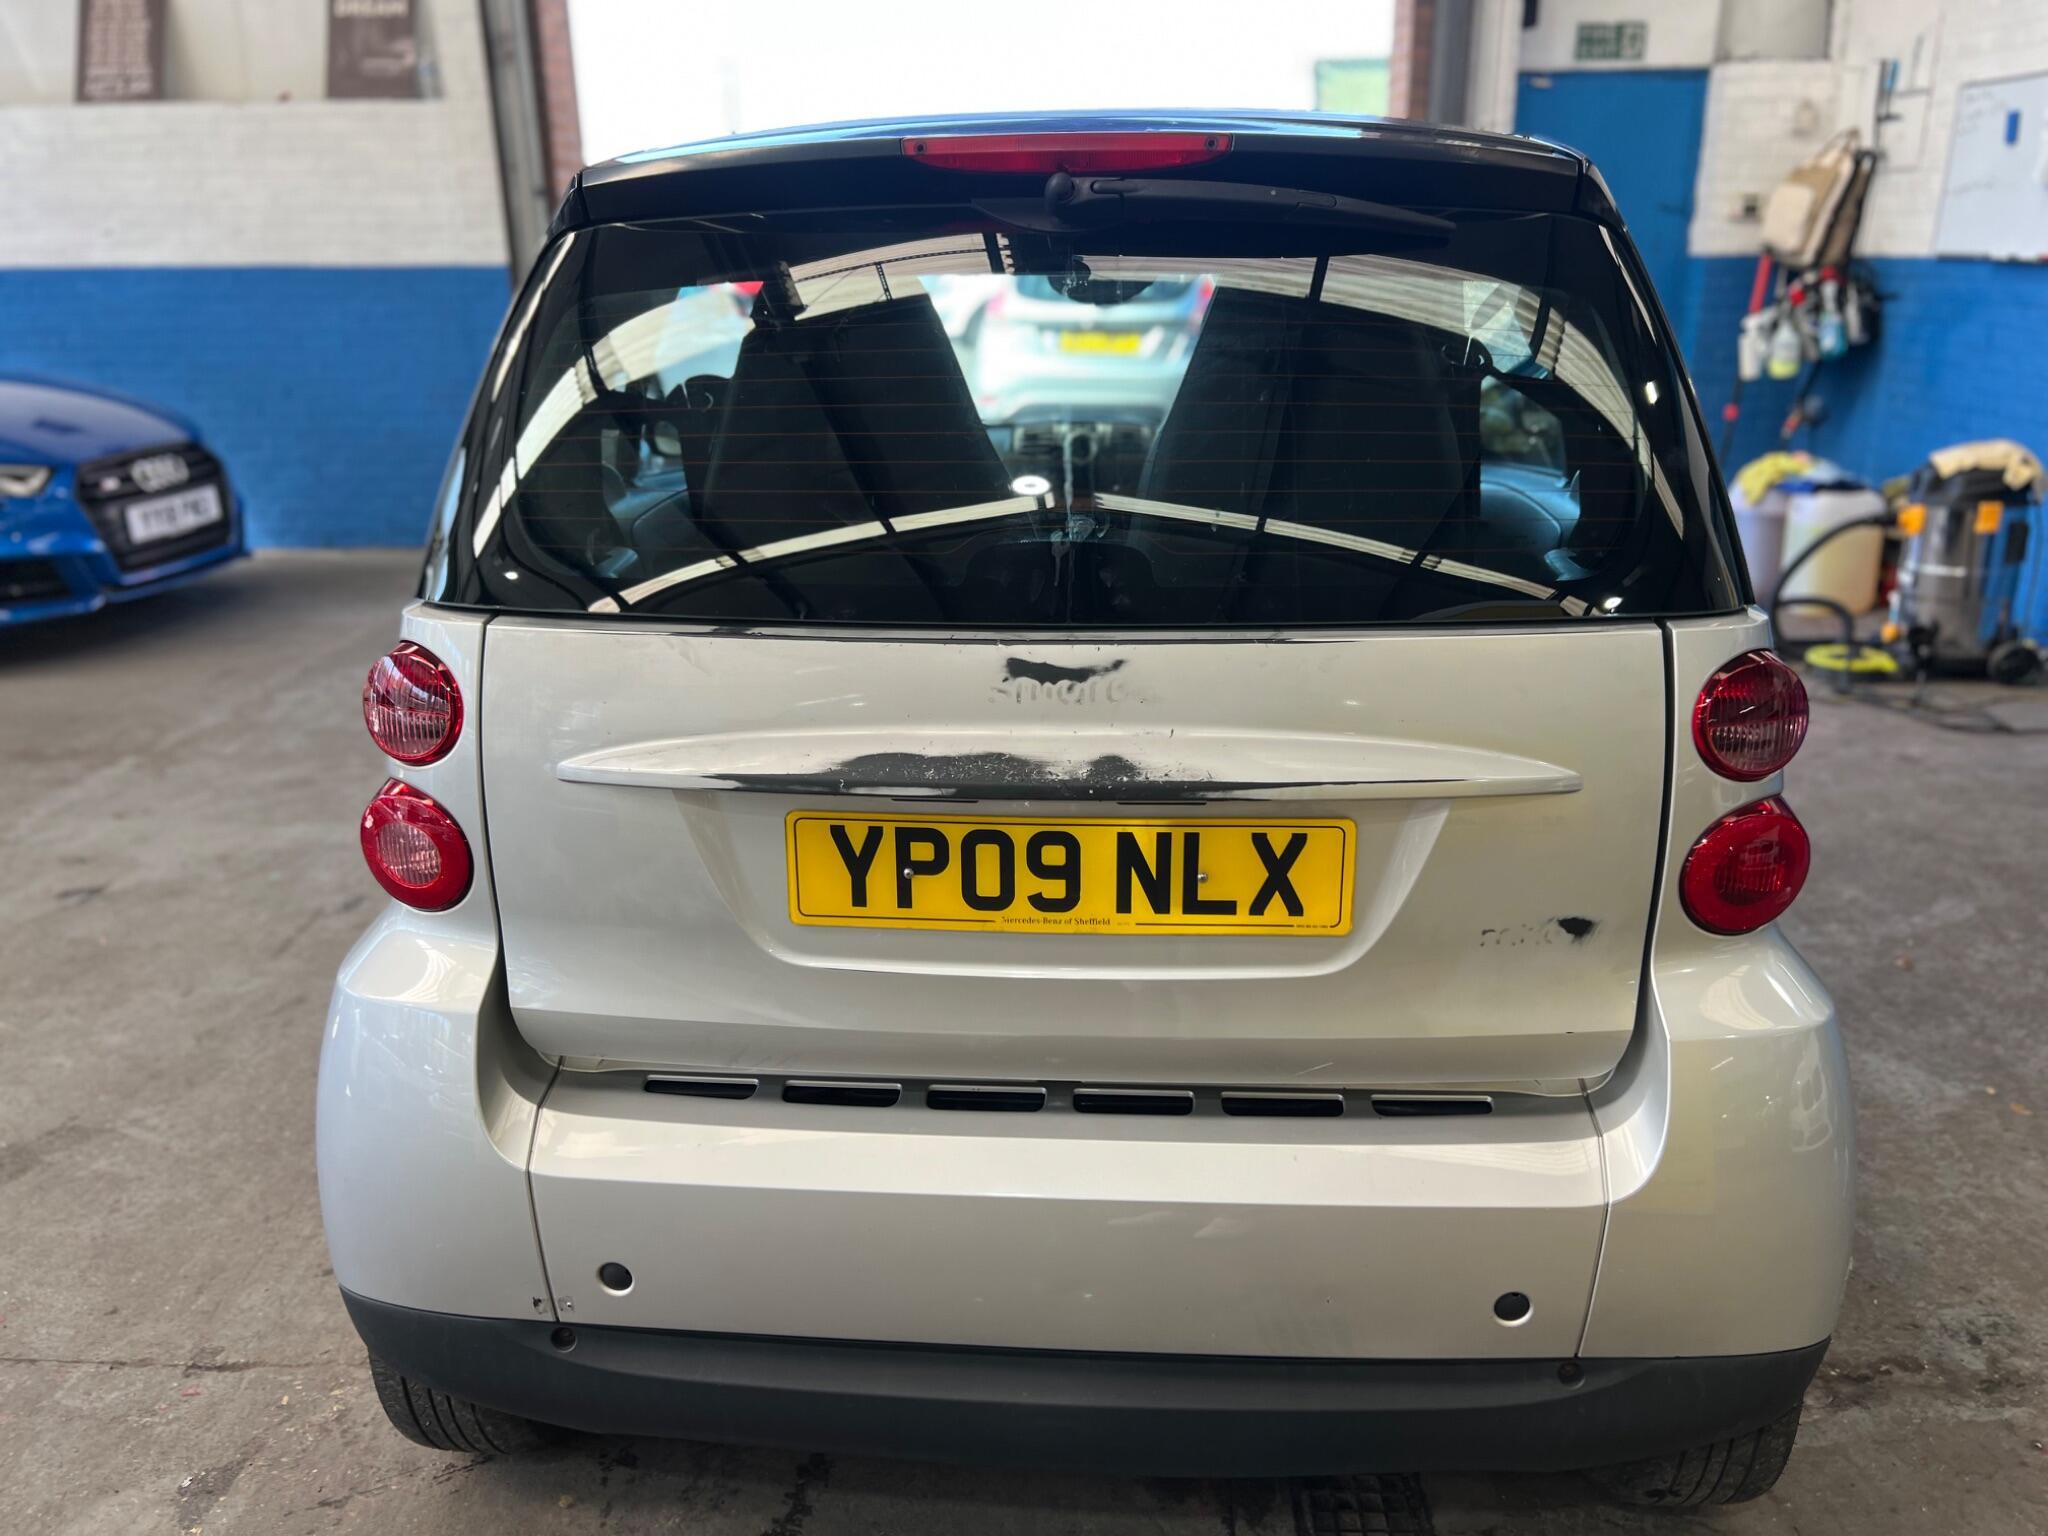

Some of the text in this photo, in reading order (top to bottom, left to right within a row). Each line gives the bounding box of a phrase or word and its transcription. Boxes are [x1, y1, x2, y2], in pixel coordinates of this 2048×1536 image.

[829, 825, 1308, 917] YP09 NLX
[1064, 917, 1073, 925] of
[1074, 917, 1111, 926] Sheffield
